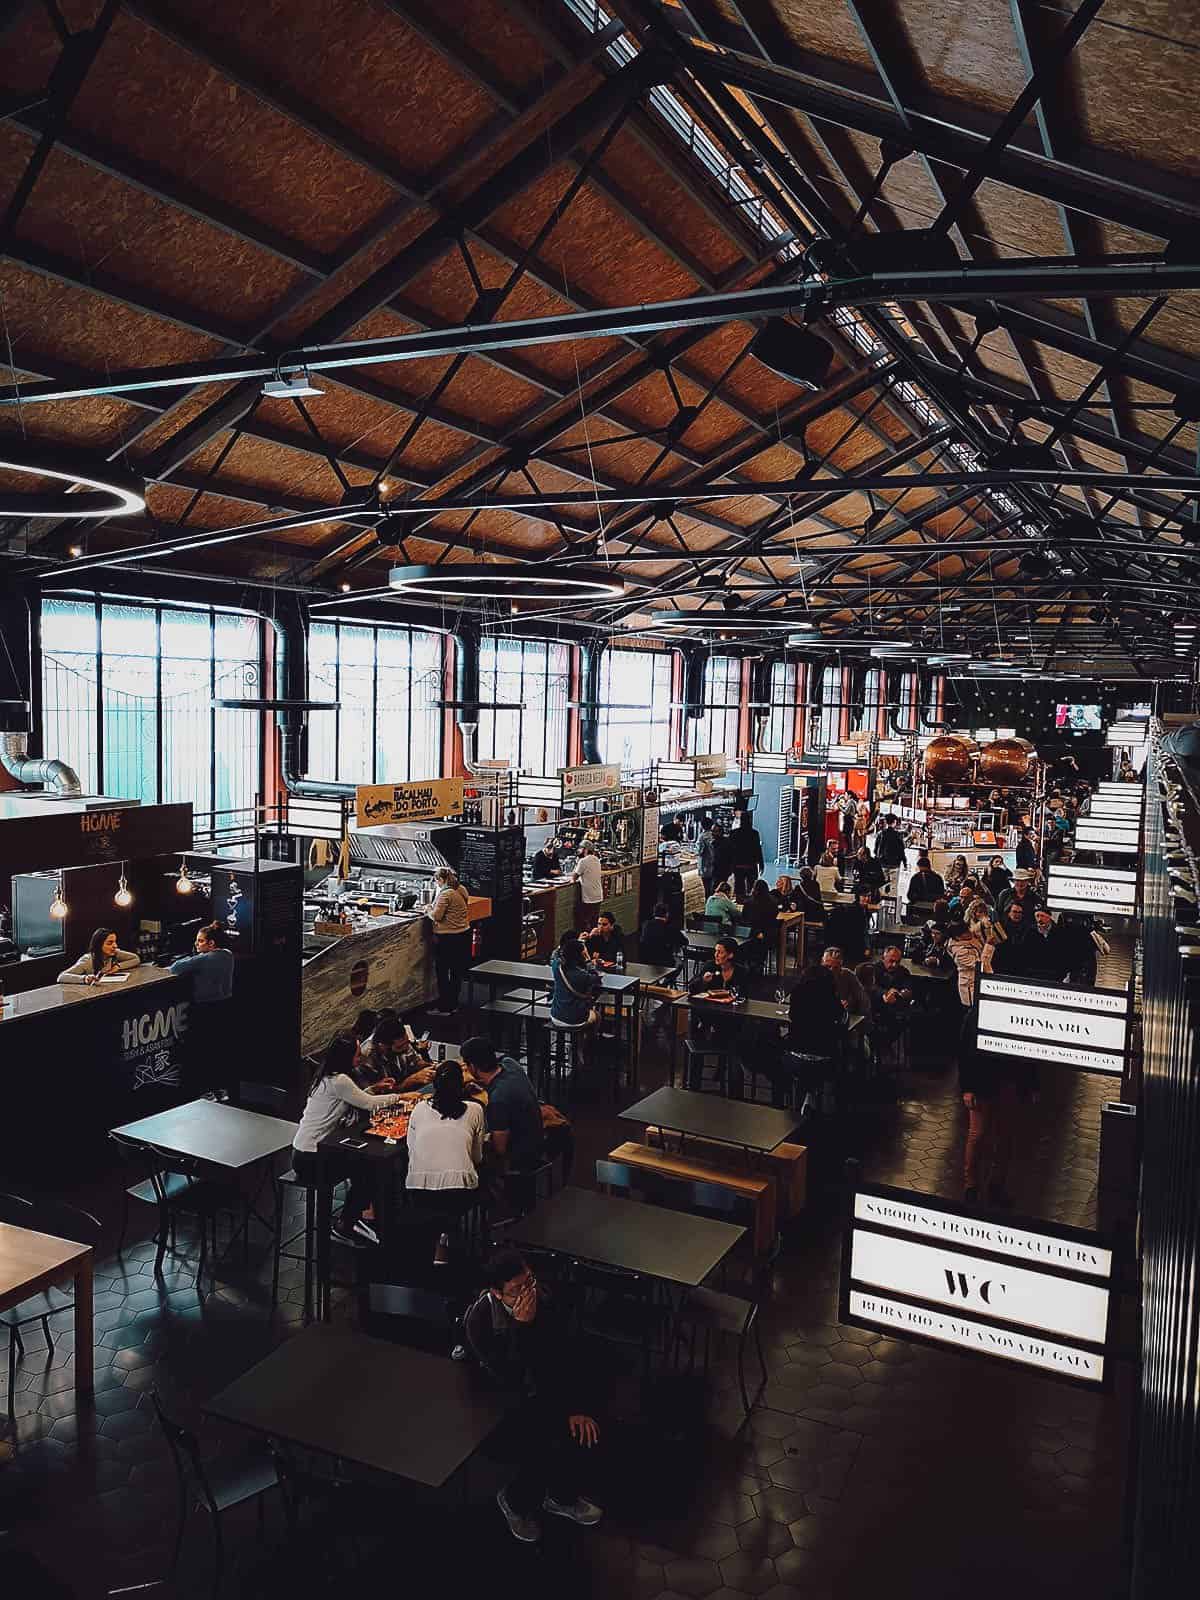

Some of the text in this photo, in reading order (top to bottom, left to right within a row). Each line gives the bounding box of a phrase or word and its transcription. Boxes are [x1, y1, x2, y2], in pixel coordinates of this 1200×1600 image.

[393, 787, 433, 802] BACALHAU
[395, 799, 409, 812] DO
[80, 812, 121, 832] HOME
[121, 1003, 187, 1050] HOME
[1010, 1014, 1091, 1036] DRINKARIA
[865, 1203, 1098, 1266] SABORES TRADIÇÃO CULTURA
[944, 1268, 1007, 1305] WC
[951, 1323, 983, 1342] VILA
[986, 1332, 1024, 1352] NOVA
[1029, 1343, 1047, 1357] DE
[1053, 1350, 1091, 1369] GAIA
